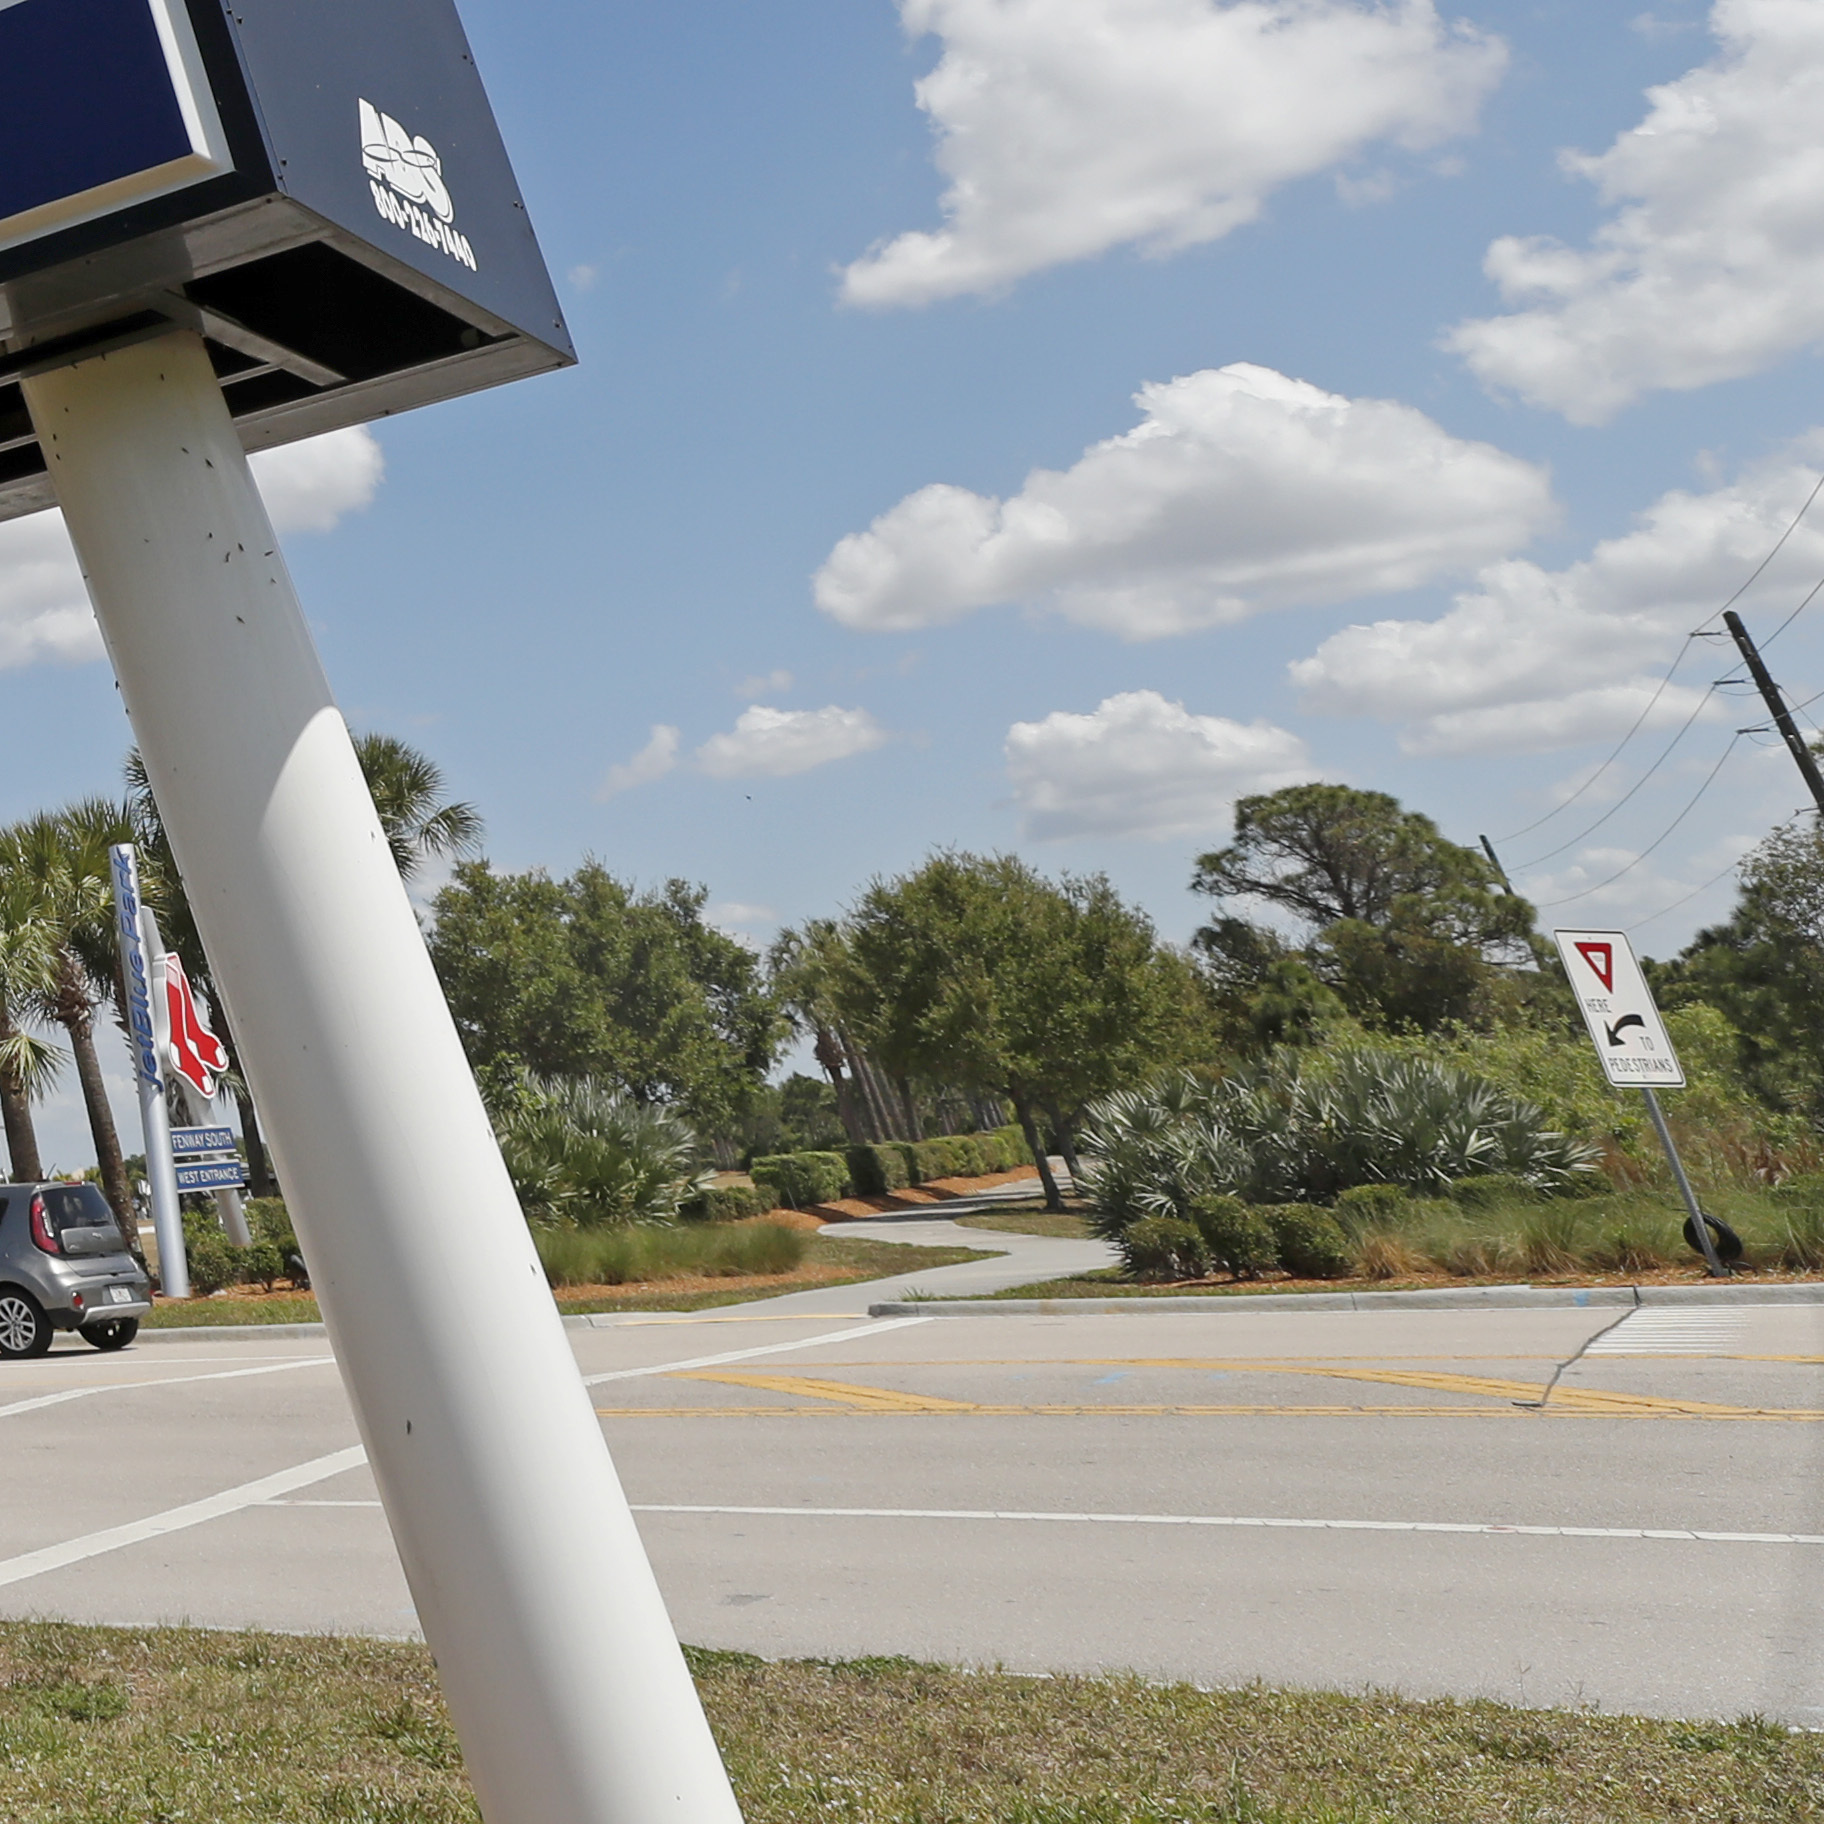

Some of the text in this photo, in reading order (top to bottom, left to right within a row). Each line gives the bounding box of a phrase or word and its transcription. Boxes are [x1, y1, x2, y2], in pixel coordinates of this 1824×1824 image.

[113, 845, 164, 1093] jetBlue Park
[1584, 998, 1612, 1013] HERE
[1638, 1036, 1655, 1051] TO
[1607, 1057, 1674, 1073] PEDESTRIANS
[172, 1131, 233, 1149] FENWAY SOUTH
[177, 1167, 240, 1184] WEST ENTRANCE
